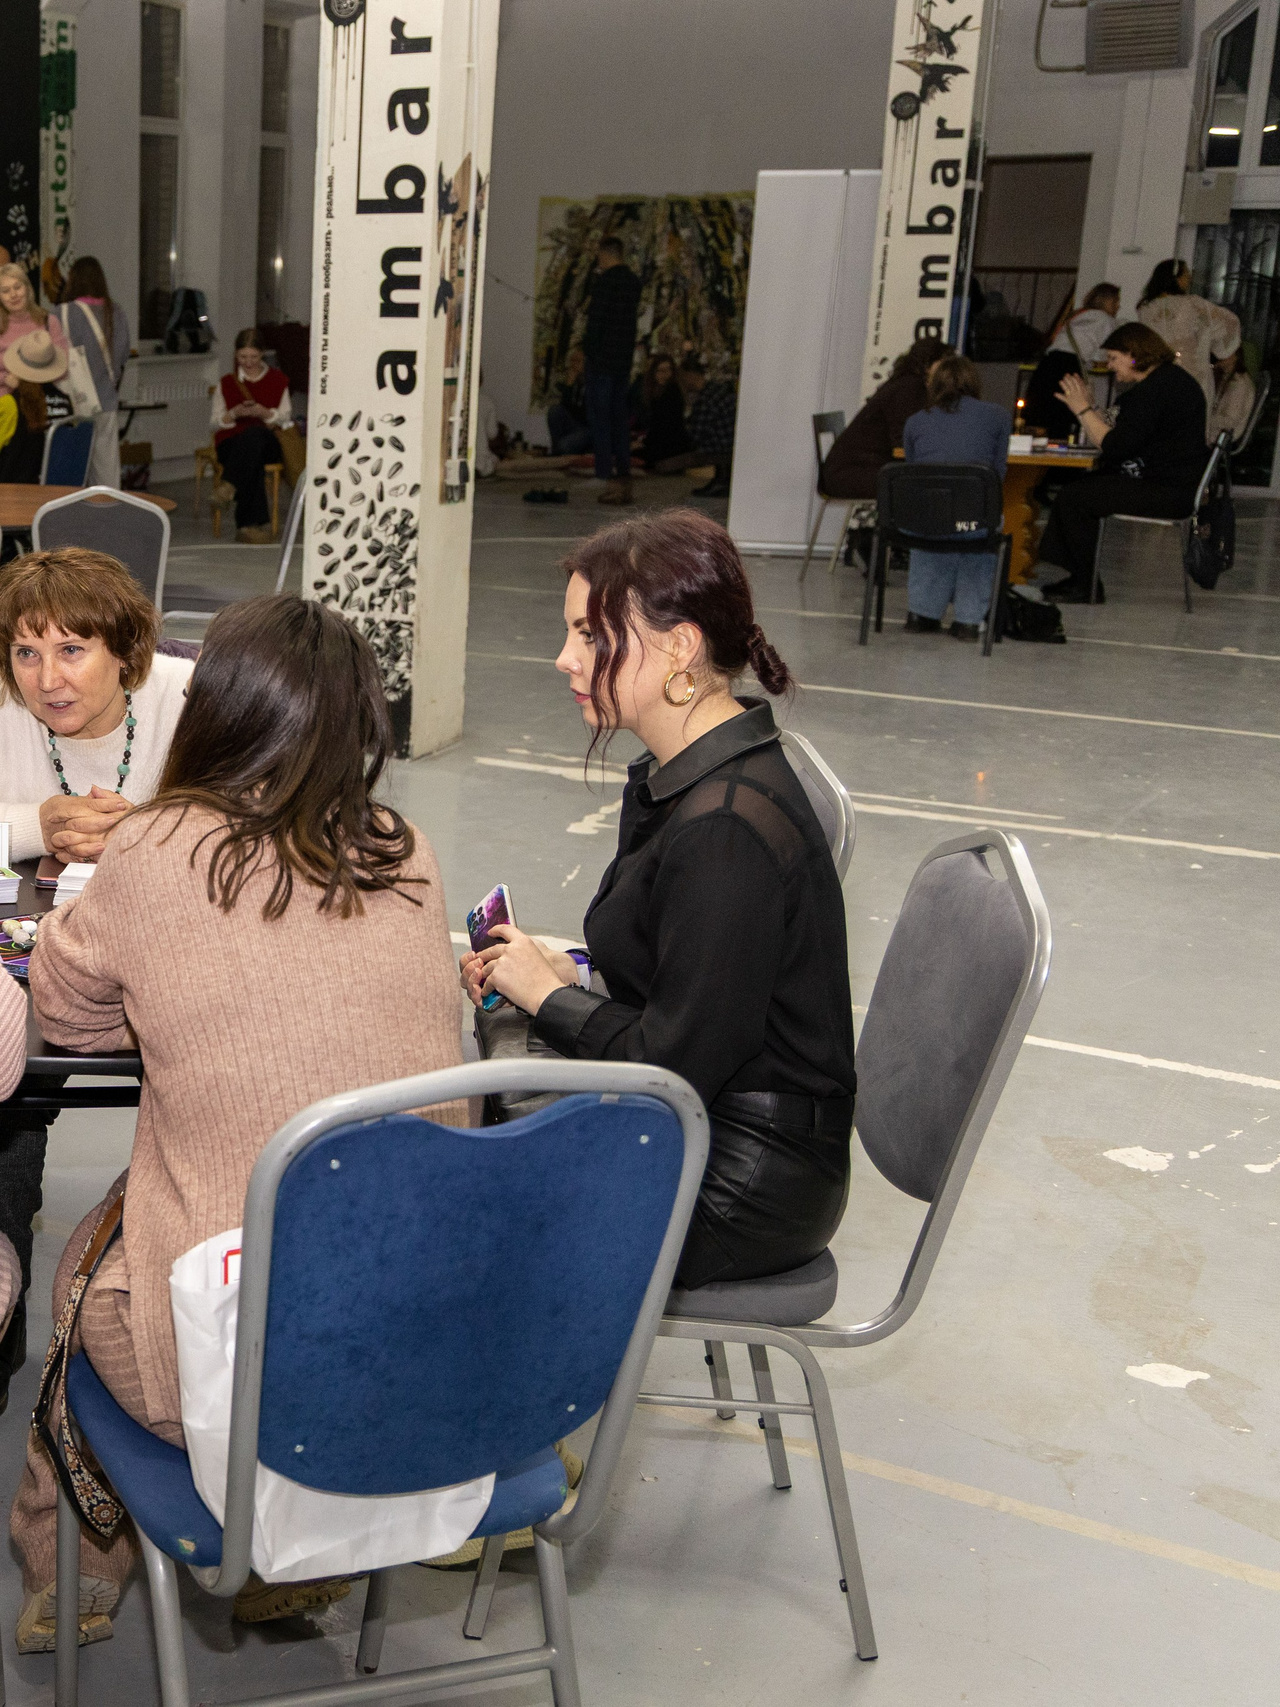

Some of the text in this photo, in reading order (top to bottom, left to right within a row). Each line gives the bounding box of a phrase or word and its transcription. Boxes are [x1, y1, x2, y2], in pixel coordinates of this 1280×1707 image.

[356, 16, 432, 396] ambar
[906, 116, 965, 344] ambar
[323, 229, 332, 289] вообразить
[322, 292, 330, 335] можешь
[322, 338, 329, 352] ты
